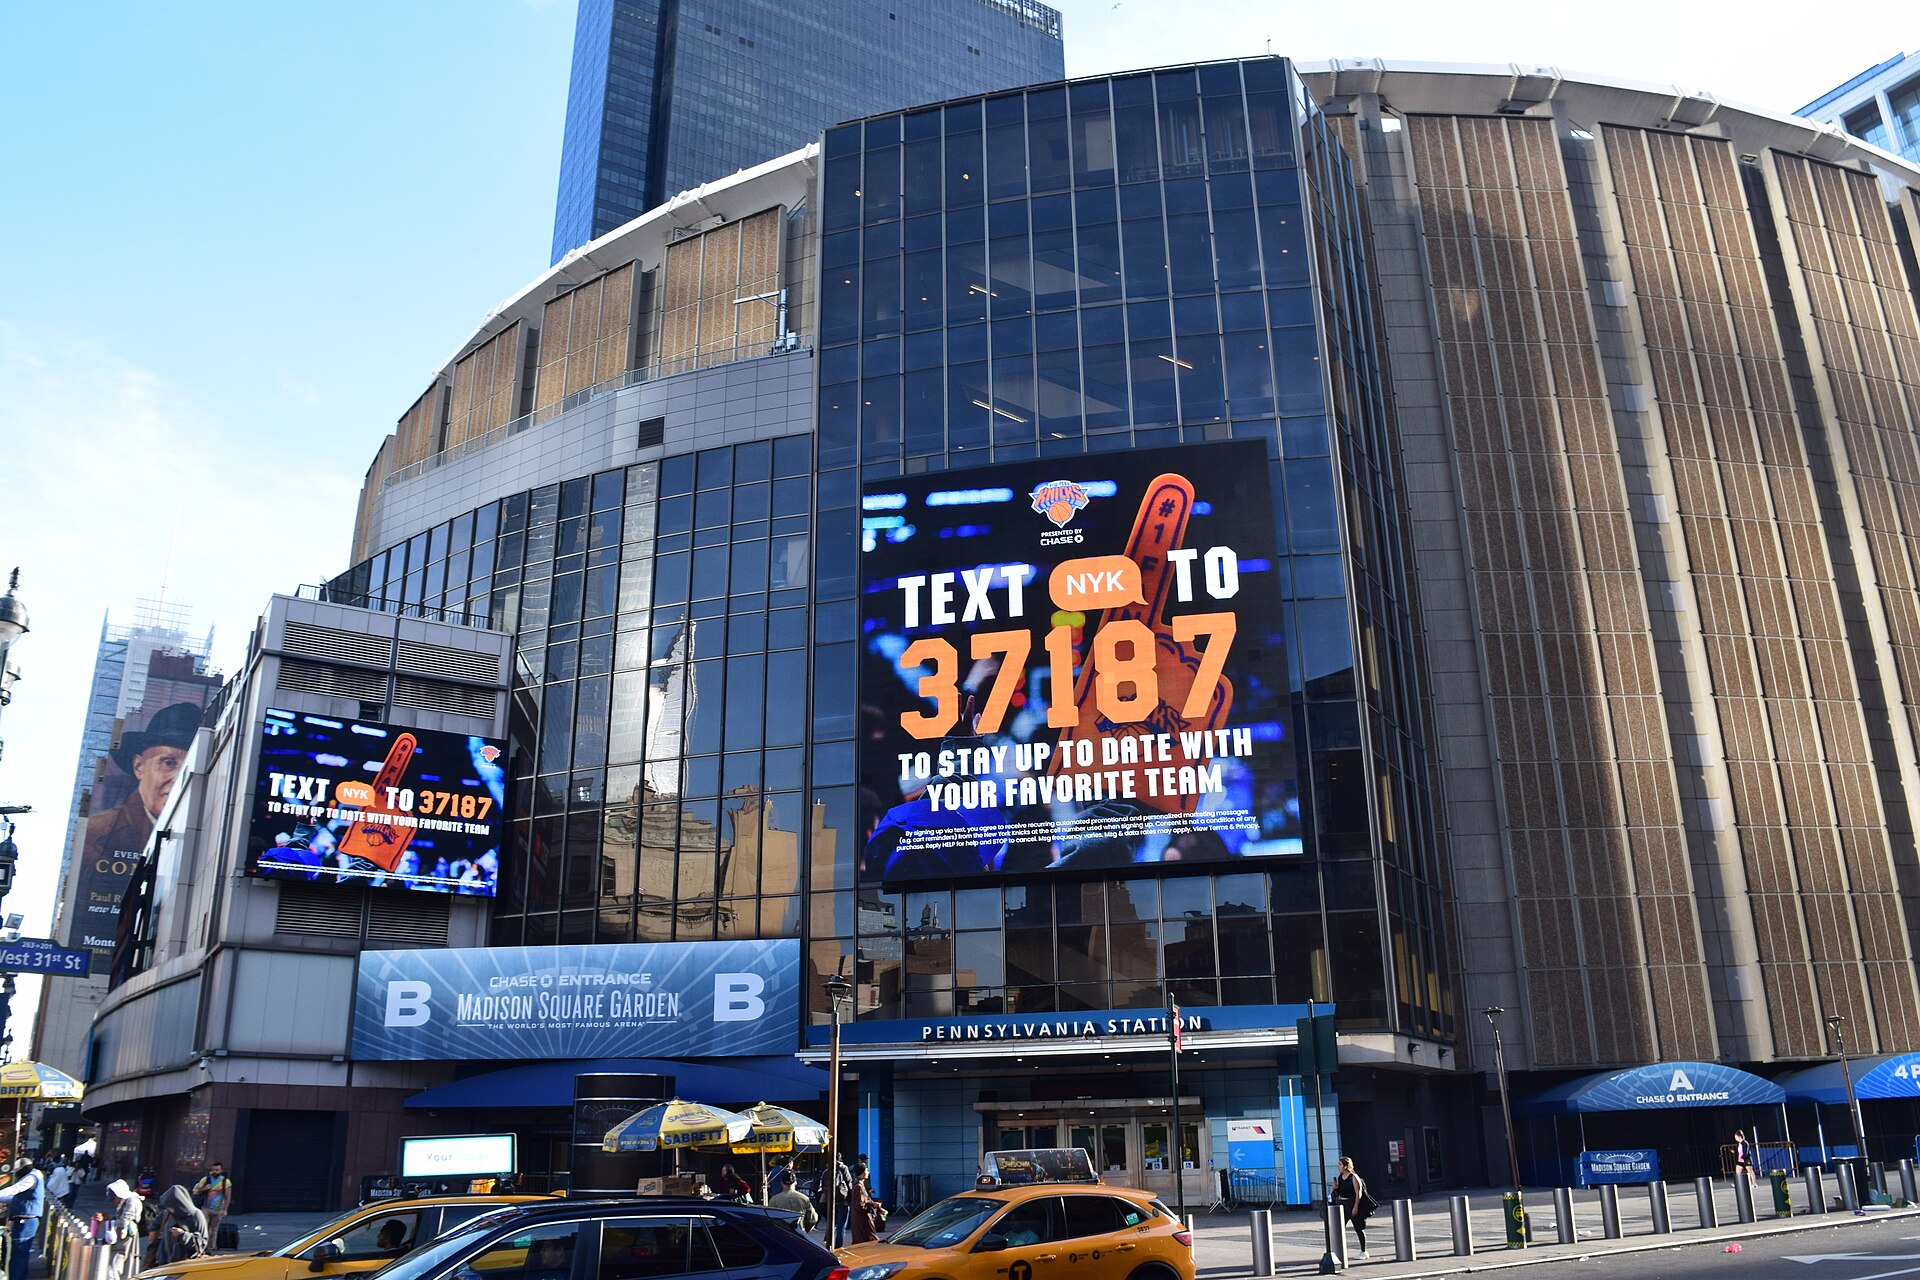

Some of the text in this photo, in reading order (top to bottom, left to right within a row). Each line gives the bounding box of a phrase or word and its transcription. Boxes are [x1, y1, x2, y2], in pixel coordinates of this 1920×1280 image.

[1034, 485, 1087, 508] KNICKS
[1040, 536, 1073, 546] CHASE
[898, 564, 1029, 628] TEXT
[1066, 570, 1125, 596] NYK
[1166, 546, 1240, 602] TO
[900, 612, 1237, 740] 37187
[898, 728, 1252, 781] TO STAY UP TO DATE WITH
[269, 772, 492, 820] TEXT NYK TO 37187
[926, 764, 1222, 812] YOUR FAVORITE TEAM
[268, 801, 490, 836] TO STAY UP TO DATE WITH YOUR FAVORITE TEAM
[914, 828, 934, 836] signing
[1028, 821, 1054, 829] recurring
[1056, 818, 1089, 826] automated
[1090, 816, 1128, 825] promotional
[1142, 813, 1182, 822] personalized
[1183, 811, 1215, 819] marketing
[925, 833, 957, 842] reminders)
[1121, 822, 1143, 830] signing
[965, 839, 978, 847] help
[1038, 835, 1051, 843] Msg
[1052, 833, 1082, 842] frequency
[1104, 831, 1117, 839] Msg
[1172, 827, 1192, 835] apply.
[1235, 823, 1260, 831] Privacy.
[114, 850, 140, 860] EVER
[90, 892, 112, 902] Paul
[32, 952, 62, 968] 31st
[64, 955, 81, 970] St
[490, 972, 652, 988] CHASE ENTRANCE
[384, 980, 432, 1027] B
[457, 990, 679, 1020] MADISON SQUARE GARDEN
[714, 972, 765, 1022] B
[922, 1020, 1096, 1040] PENNSYLVANIA
[1670, 1070, 1694, 1091] A
[1894, 1064, 1908, 1080] 4
[1636, 1092, 1729, 1104] CHASE ENTRANCE
[664, 1130, 723, 1145] SABRETT
[426, 1153, 454, 1162] Your
[1591, 1164, 1612, 1172] MADISON
[1613, 1162, 1631, 1171] SQUARE
[1632, 1162, 1650, 1170] GARDEN
